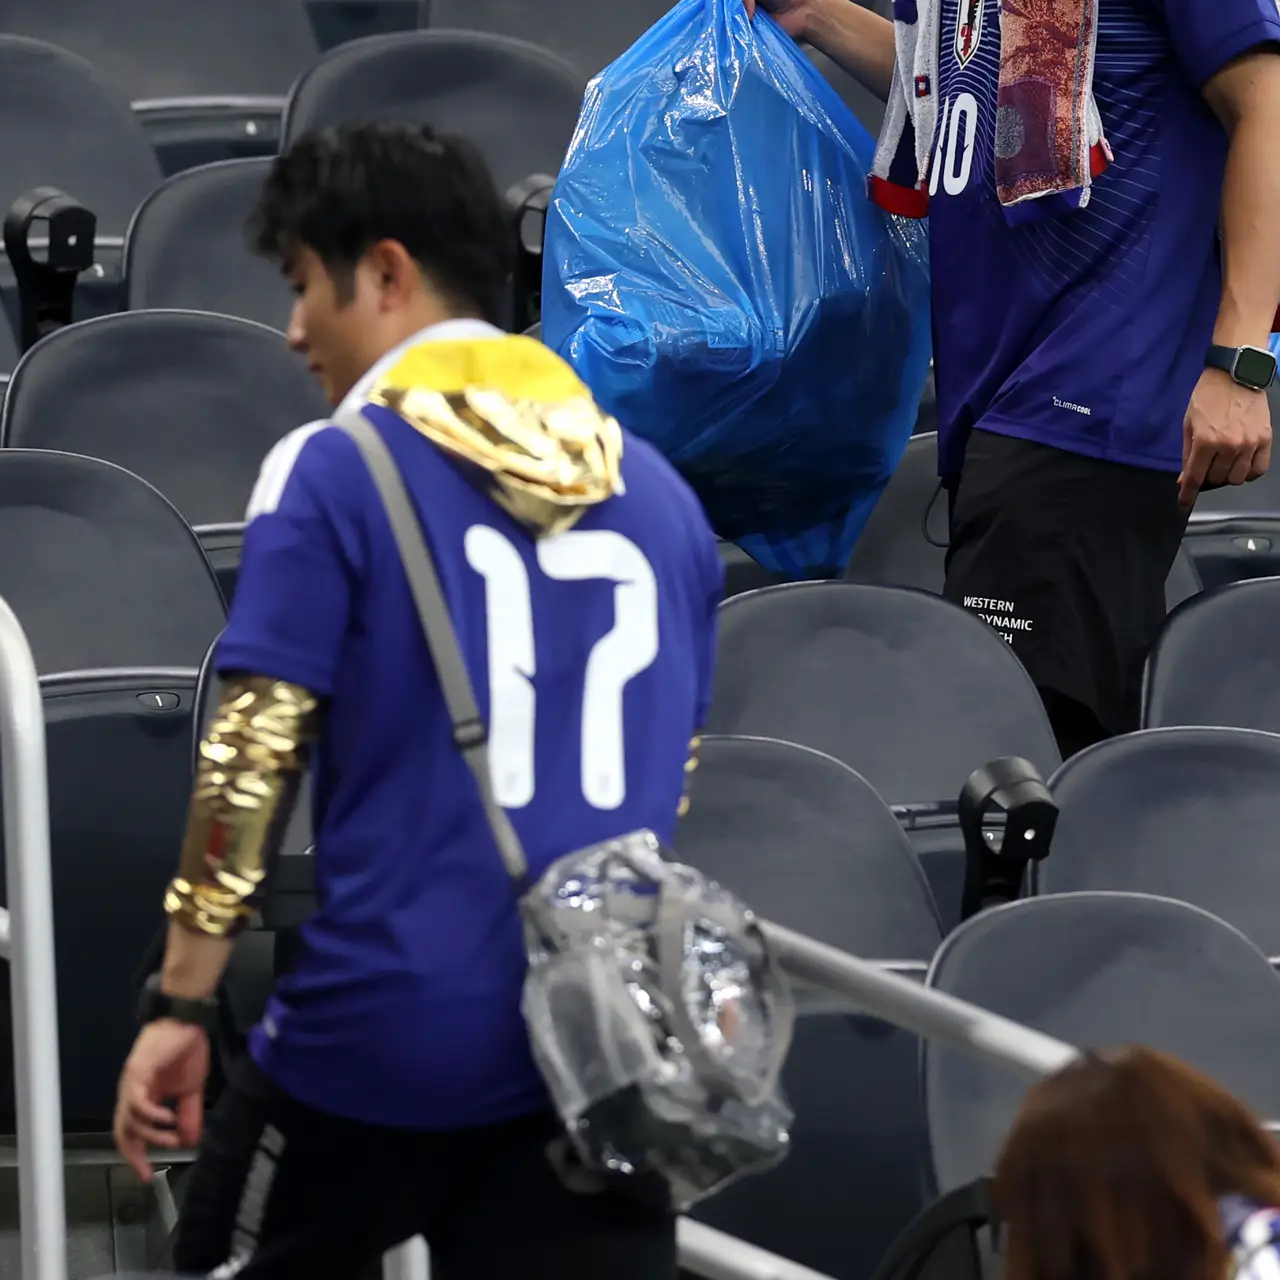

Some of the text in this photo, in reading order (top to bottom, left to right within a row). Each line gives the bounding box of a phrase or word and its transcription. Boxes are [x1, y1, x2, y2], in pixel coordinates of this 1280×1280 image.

[928, 92, 978, 197] 10
[1247, 538, 1256, 551] 4
[963, 595, 1015, 613] WESTERN
[464, 524, 660, 810] 17
